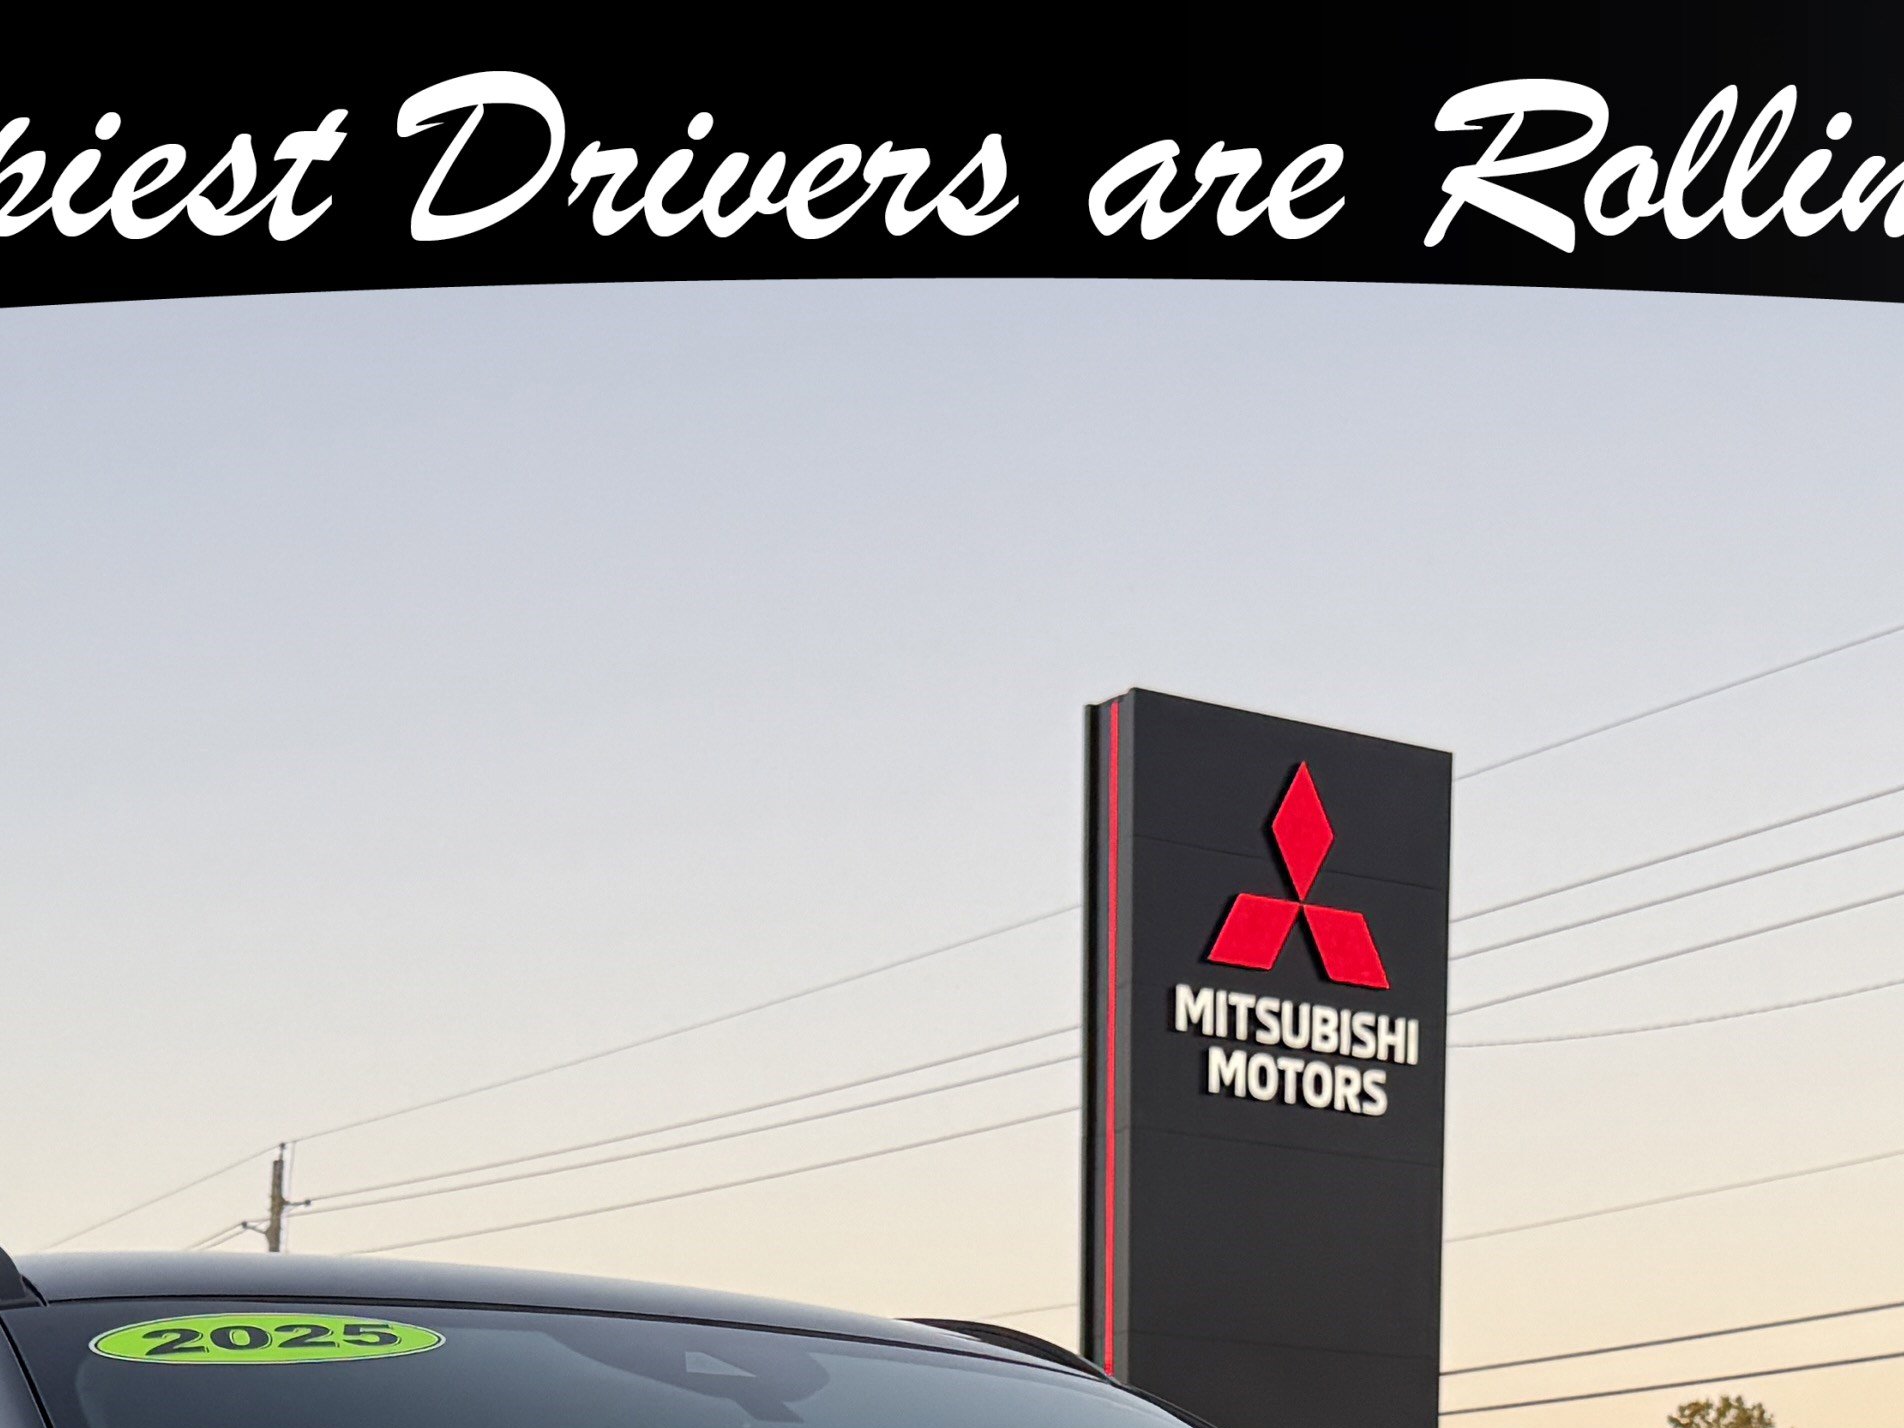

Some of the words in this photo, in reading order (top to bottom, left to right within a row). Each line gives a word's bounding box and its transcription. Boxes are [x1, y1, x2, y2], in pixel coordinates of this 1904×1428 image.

[1174, 984, 1420, 1065] MITSUBISHI
[1207, 1046, 1388, 1116] MOTORS
[142, 1323, 401, 1356] 2025
